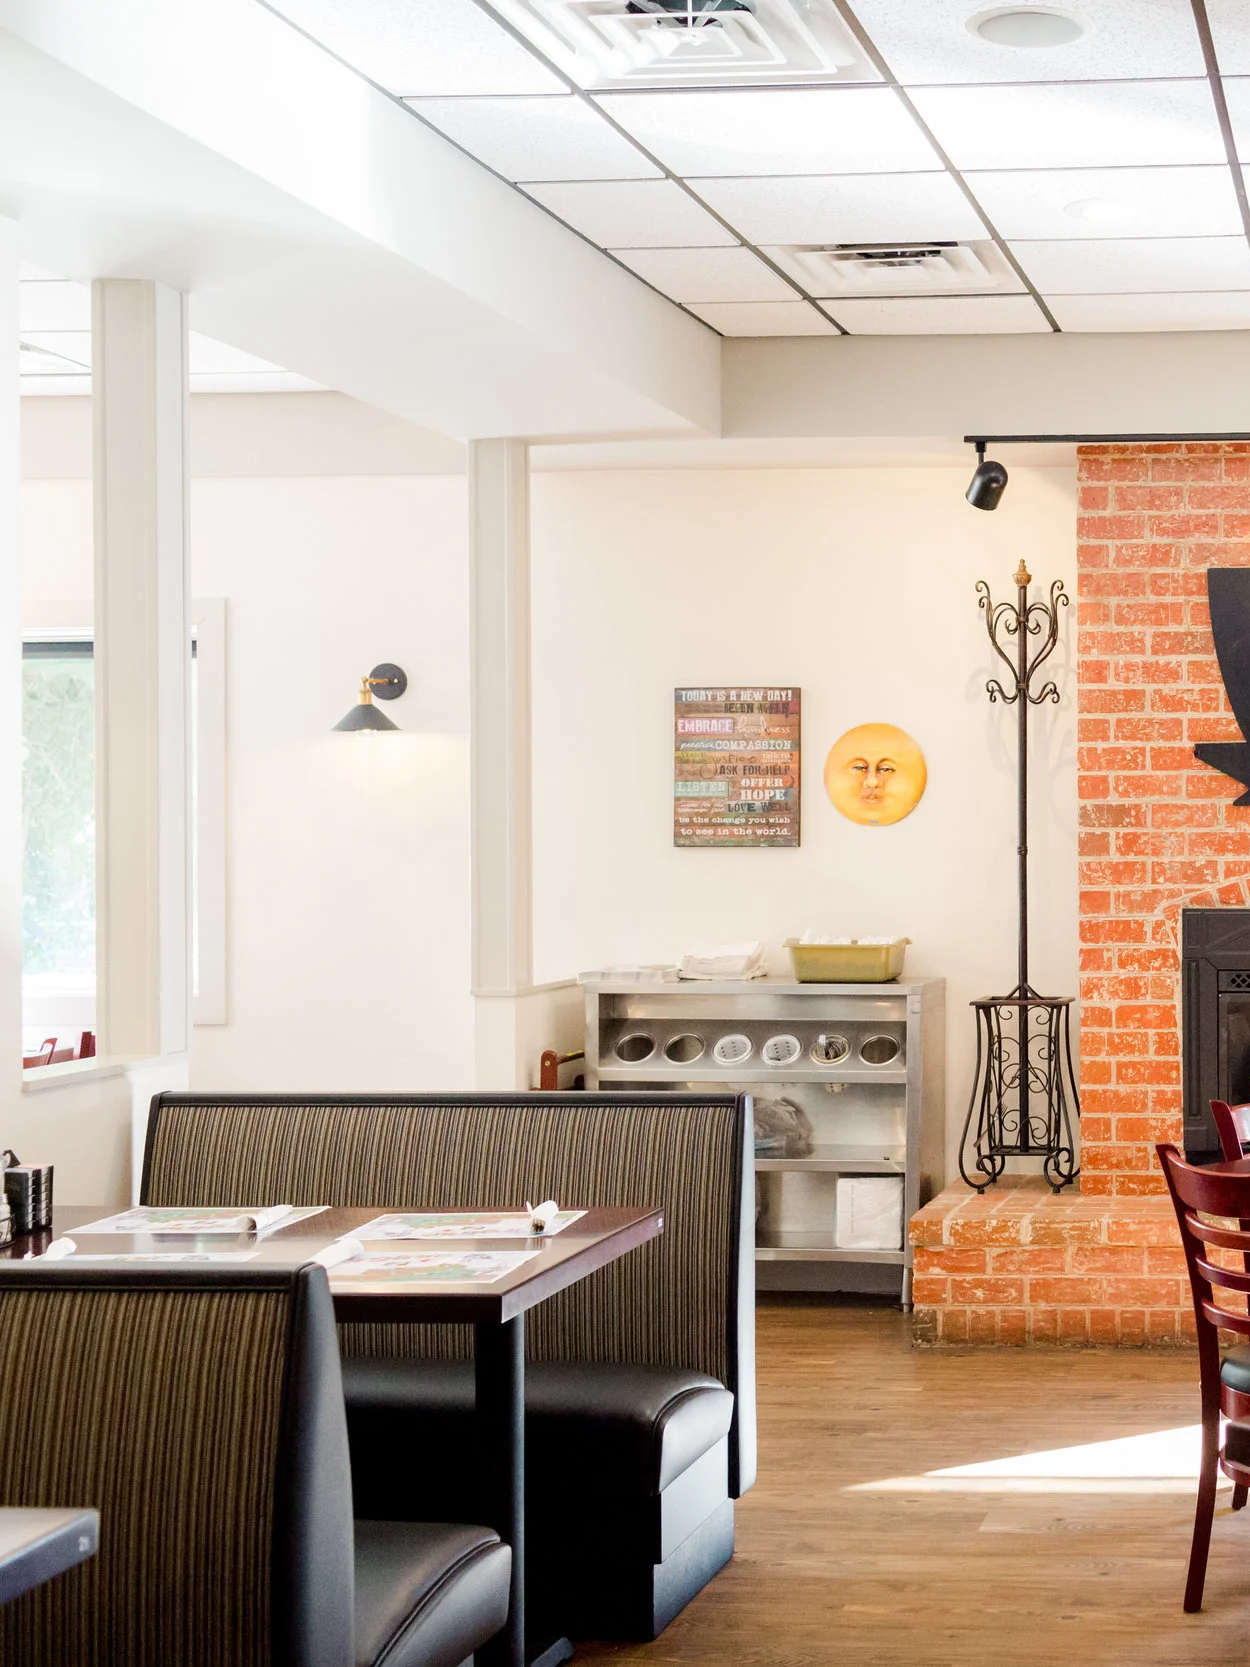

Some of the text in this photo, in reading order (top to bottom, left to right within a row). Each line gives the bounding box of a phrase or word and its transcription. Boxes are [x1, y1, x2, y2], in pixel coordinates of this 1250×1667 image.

[681, 690, 792, 702] TODAY IS A NEW DAY!
[677, 718, 733, 733] EMBRACE
[715, 740, 791, 750] COMPASSION
[719, 765, 791, 776] ASK FOR HELP
[677, 782, 726, 792] LISTEN
[740, 777, 784, 787] OFFER
[740, 789, 786, 800] HOPE
[727, 802, 756, 813] LOVE
[760, 802, 791, 813] WELL
[711, 816, 746, 825] change
[748, 817, 766, 825] you
